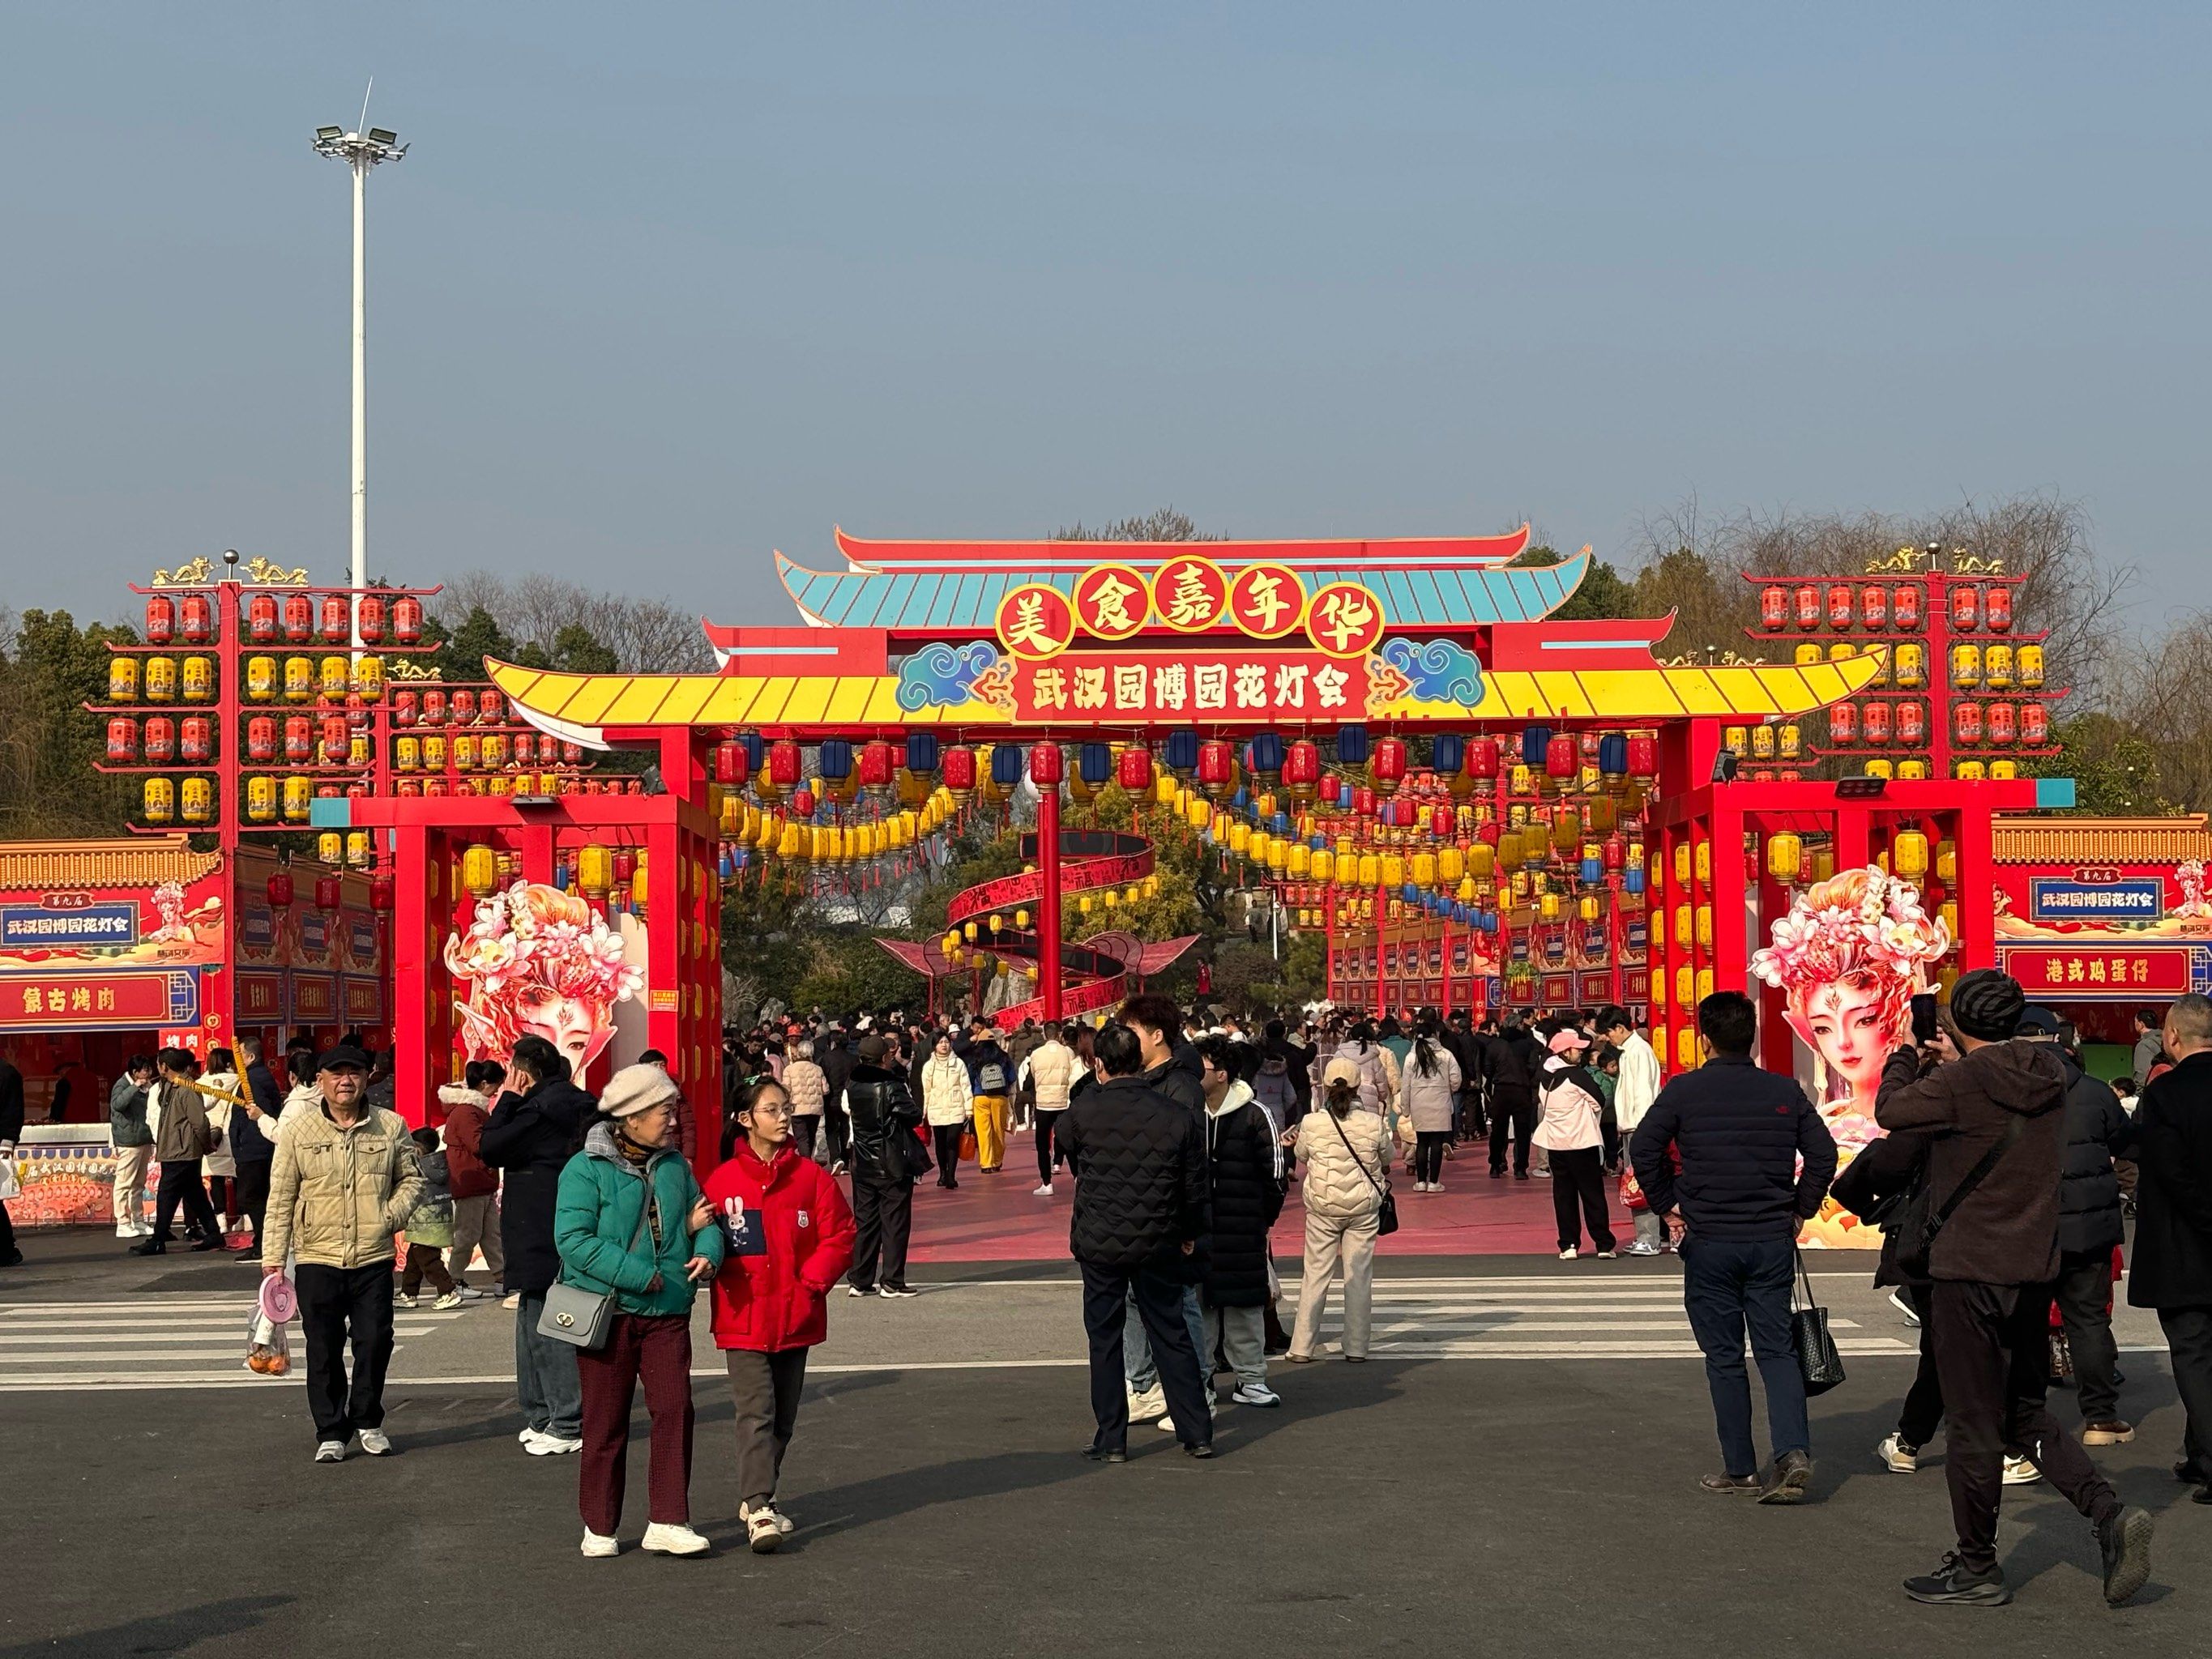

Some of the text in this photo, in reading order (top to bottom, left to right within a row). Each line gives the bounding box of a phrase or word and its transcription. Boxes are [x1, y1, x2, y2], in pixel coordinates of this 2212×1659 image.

[1008, 563, 1374, 654] 美食嘉年华
[1032, 663, 1350, 711] 武汉园博园花灯会
[2083, 870, 2112, 882] 第九届
[51, 894, 83, 907] 第九届
[2042, 892, 2154, 907] 武汉园博园花灯会
[7, 917, 129, 935] 武汉园博园花灯会
[2046, 957, 2149, 983] 港式鸡蛋仔
[22, 986, 115, 1014] 蒙古烤肉
[166, 1033, 199, 1048] 烤肉
